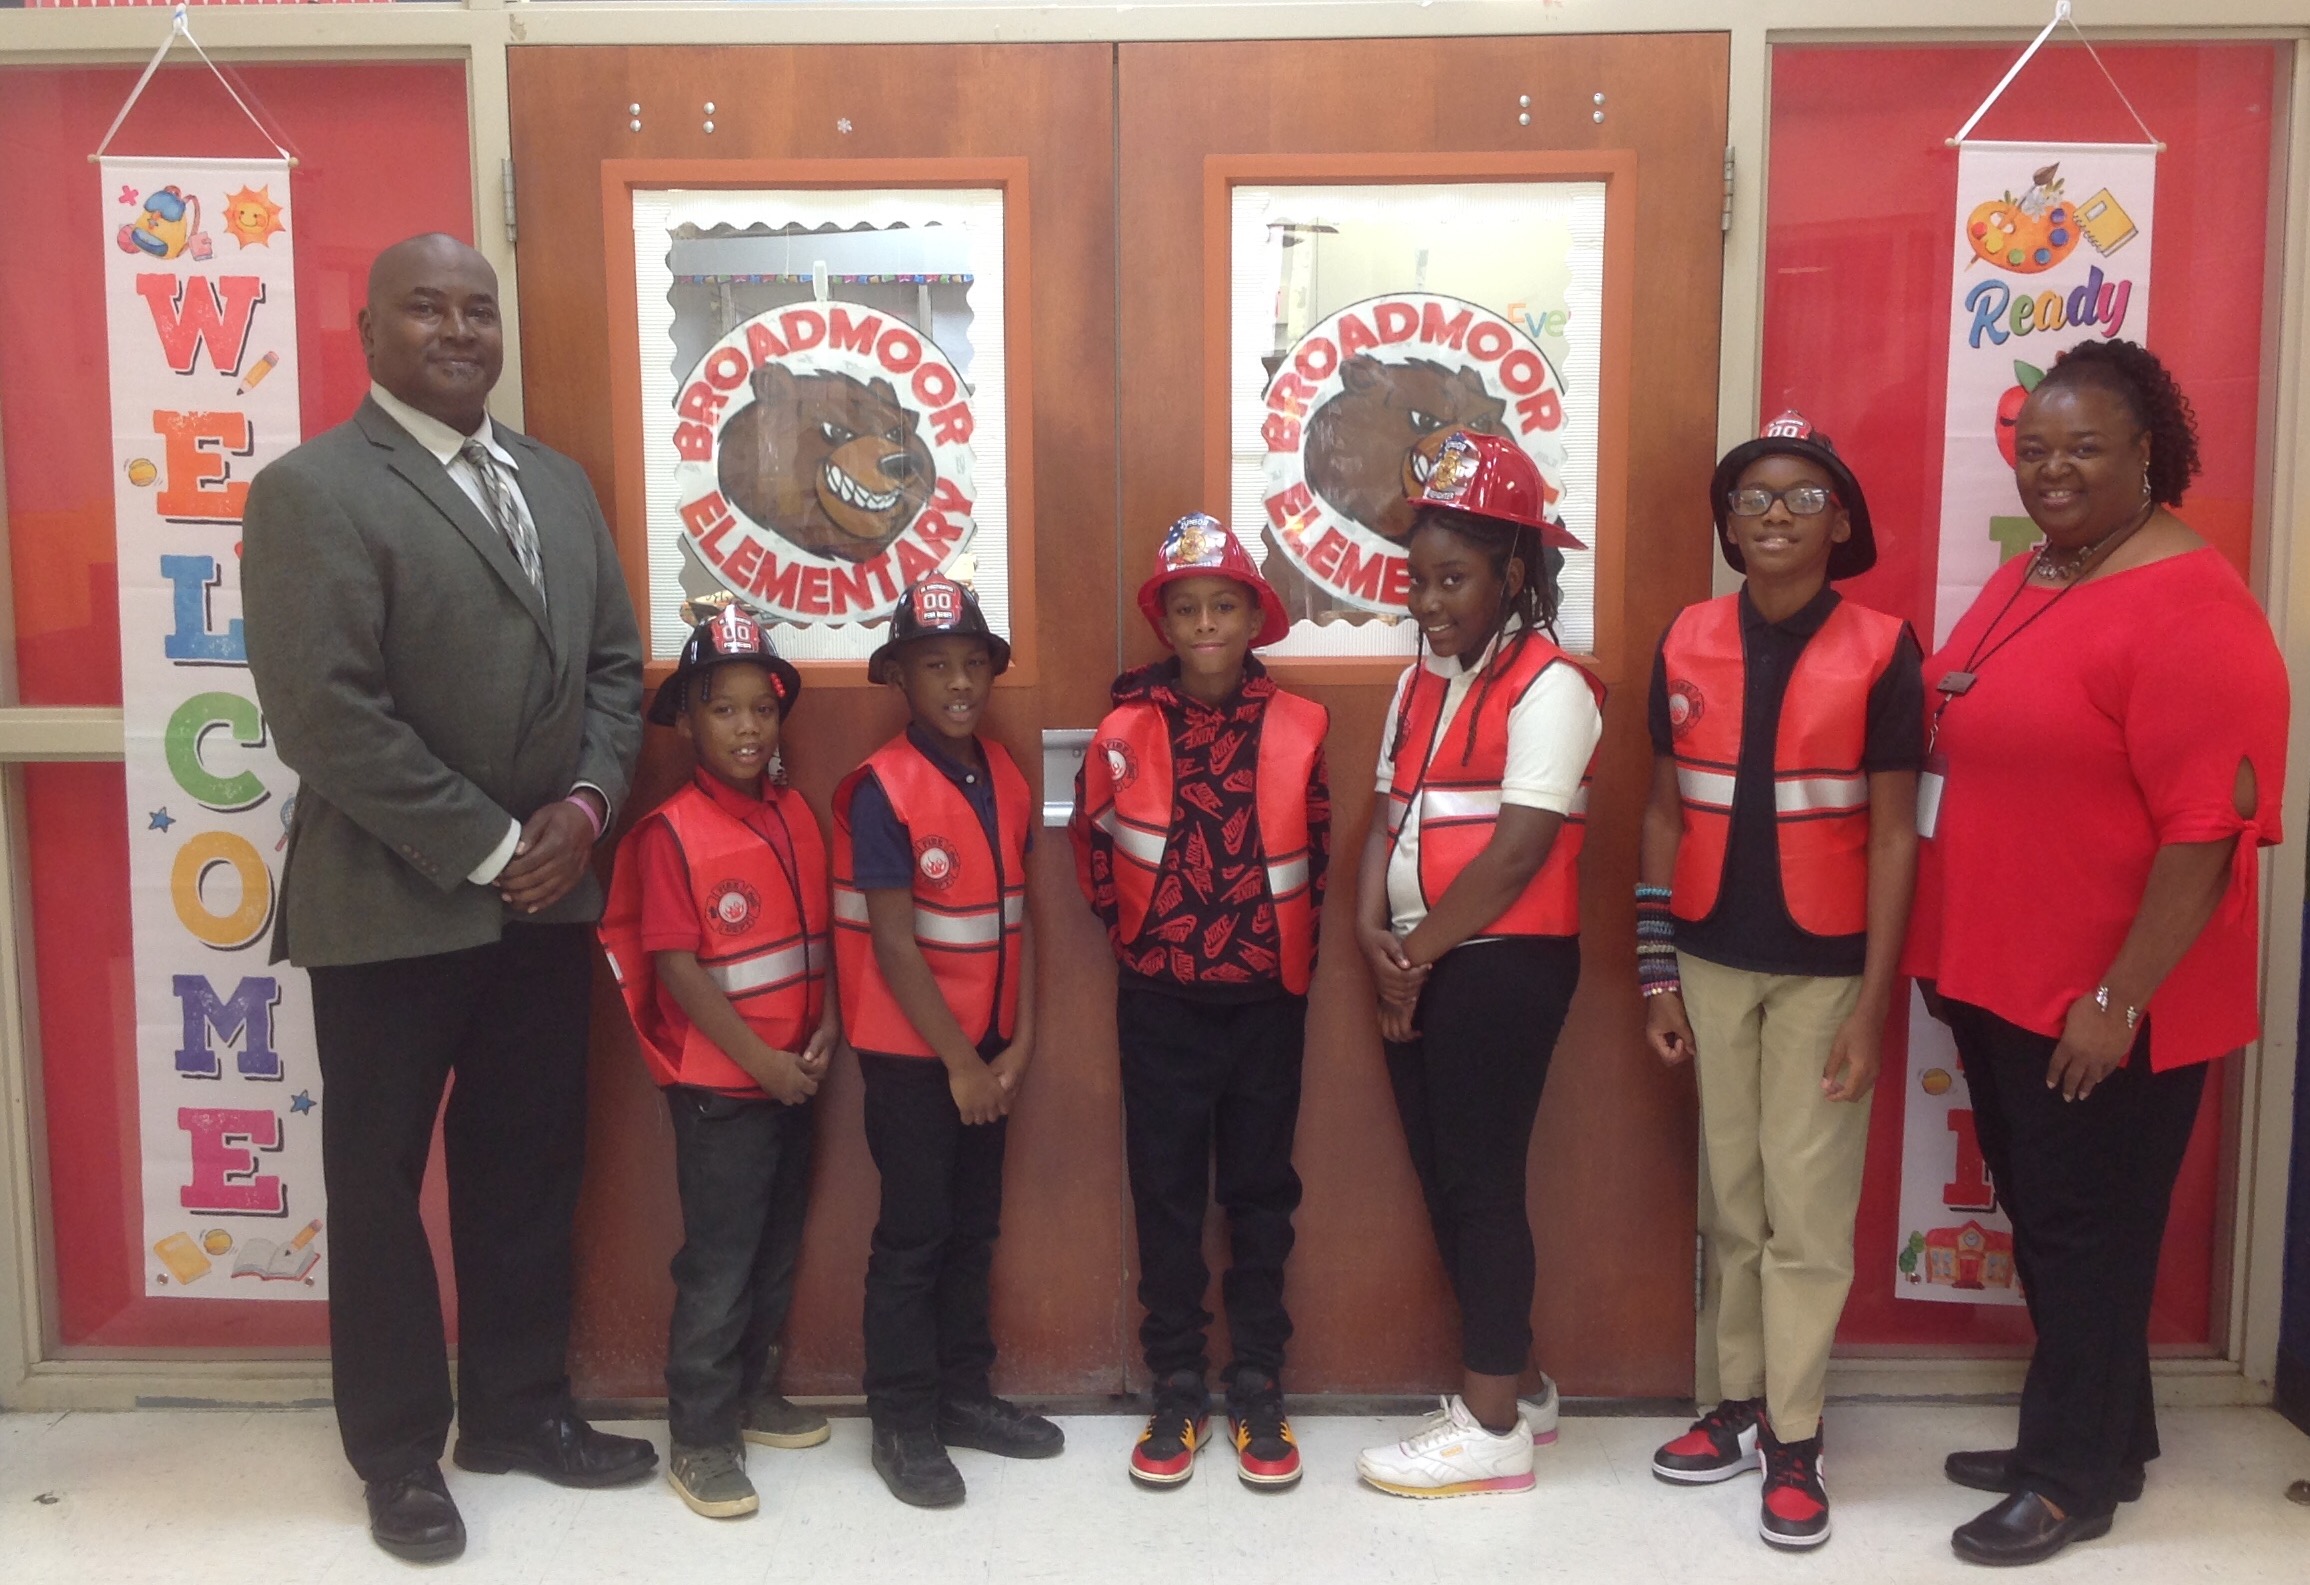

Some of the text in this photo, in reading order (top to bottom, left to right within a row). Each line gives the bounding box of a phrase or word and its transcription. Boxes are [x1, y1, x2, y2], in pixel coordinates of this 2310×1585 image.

[1507, 303, 1571, 338] Eve
[1965, 265, 2132, 349] Ready
[674, 308, 975, 463] BROADMOOR
[1262, 302, 1562, 453] BROADMOOR
[679, 476, 973, 616] ELEMENTARY
[923, 593, 951, 610] 00
